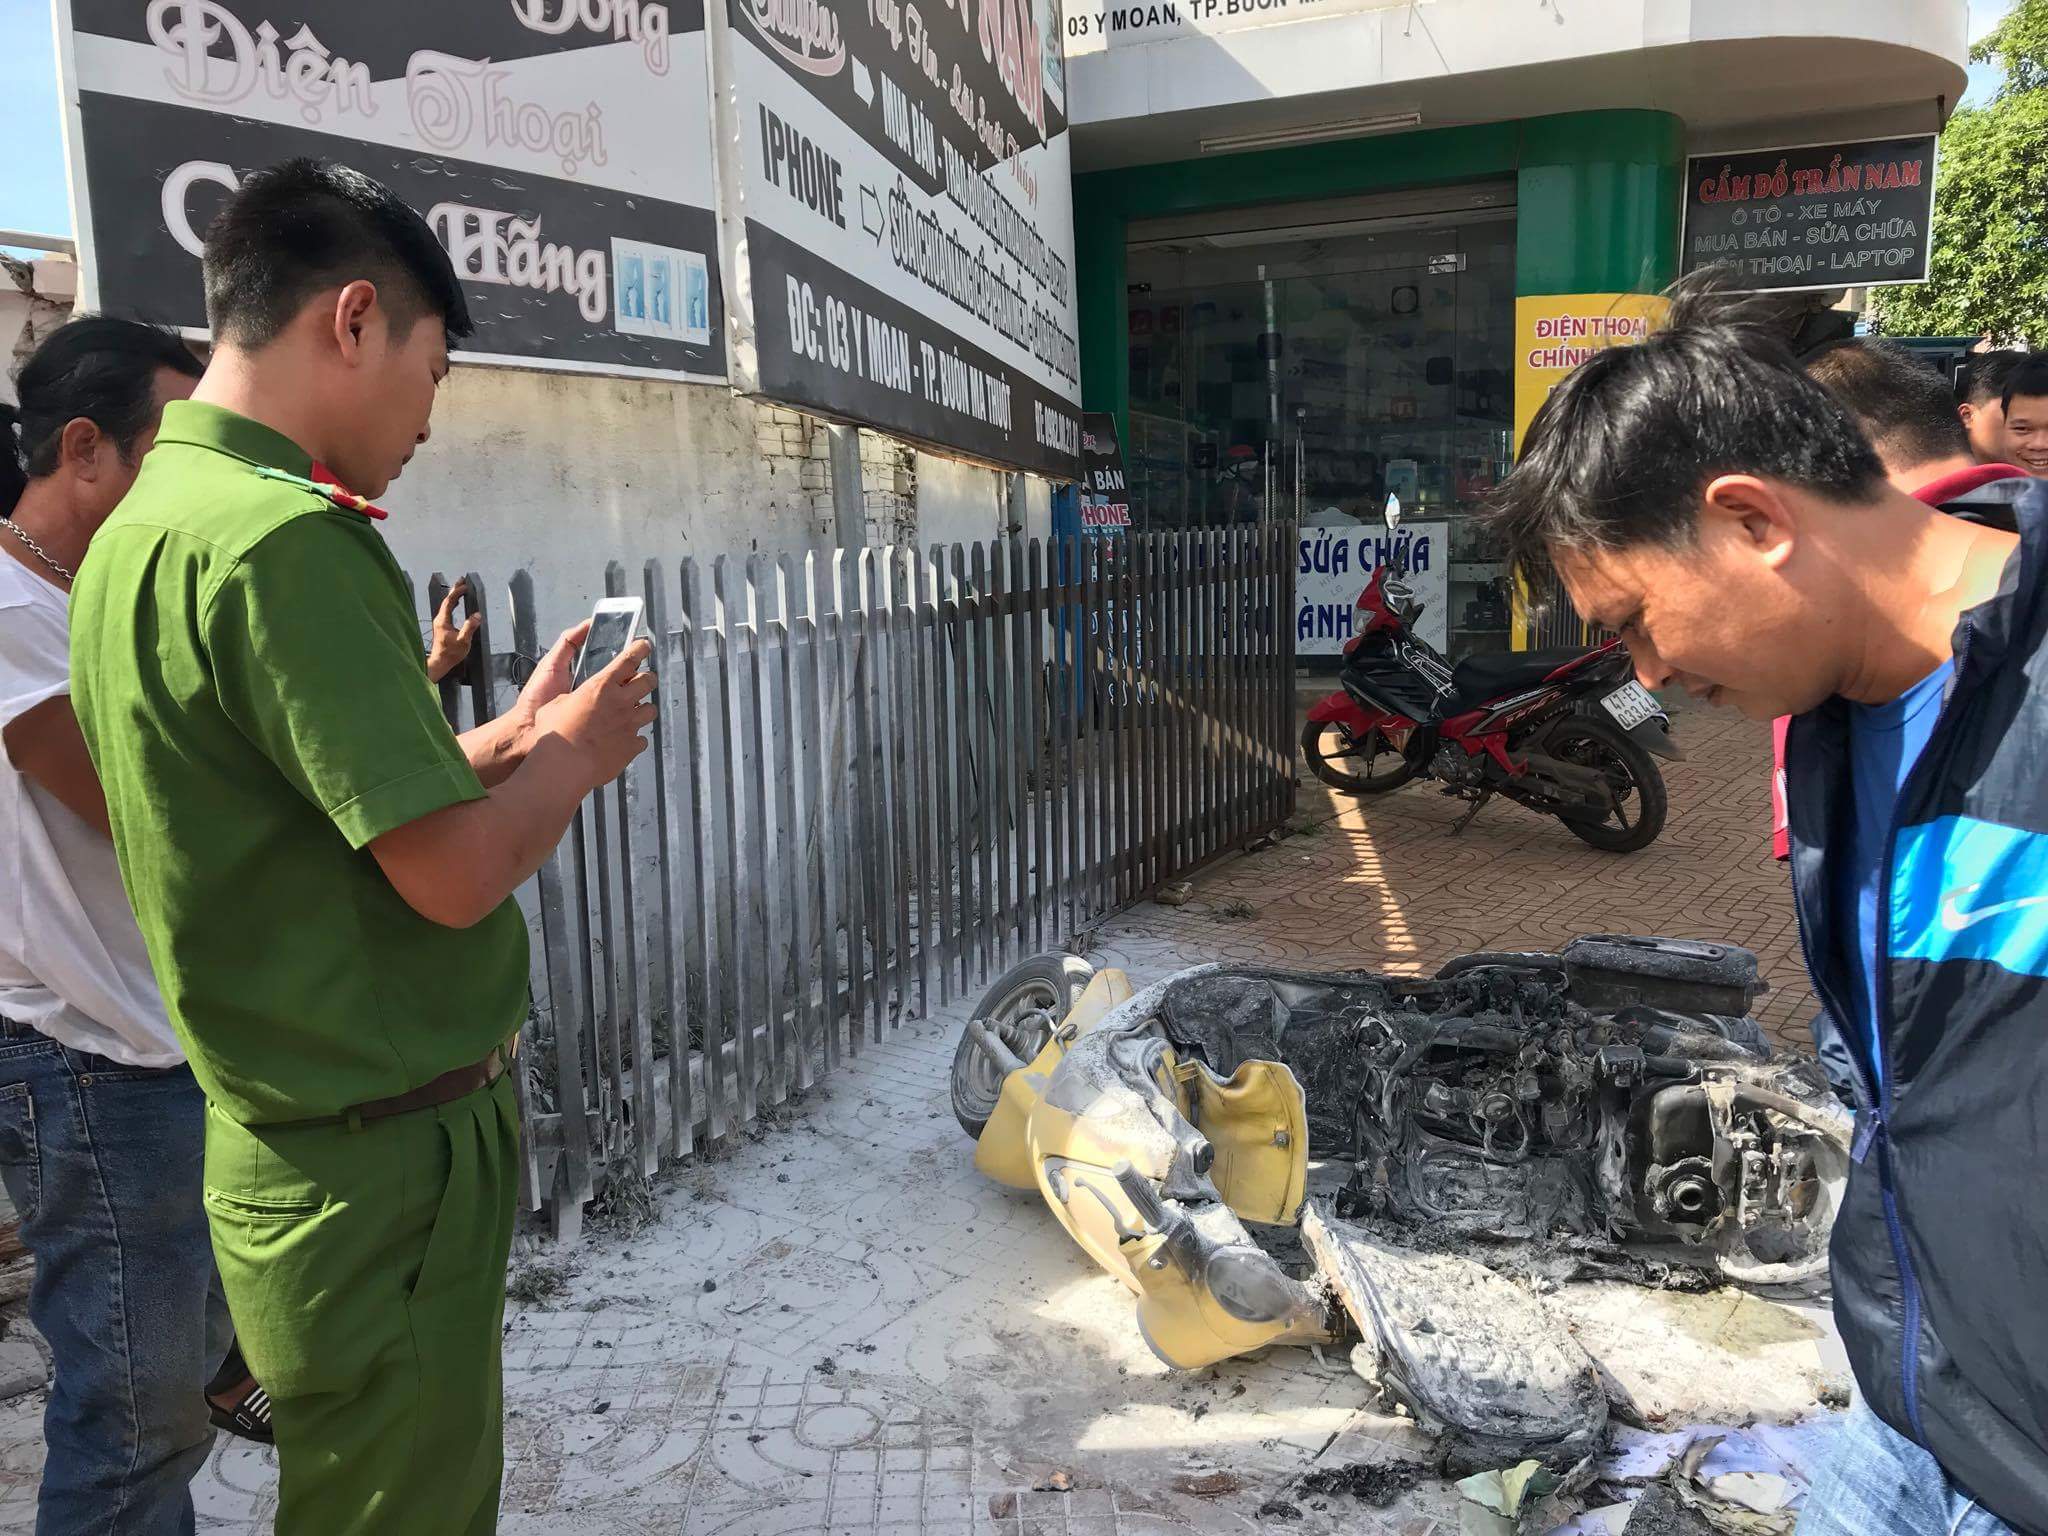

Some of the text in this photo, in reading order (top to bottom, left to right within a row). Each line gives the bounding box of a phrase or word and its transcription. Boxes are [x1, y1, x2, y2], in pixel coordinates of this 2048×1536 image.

[1068, 15, 1088, 36] 03
[1095, 13, 1105, 34] Y
[1112, 4, 1181, 31] MOAN,
[147, 0, 608, 174] Điện Thoại
[759, 102, 846, 229] IPHONE
[1864, 159, 1923, 190] NAM
[1731, 207, 1748, 225] Ô
[1752, 204, 1782, 224] TÔ
[1798, 203, 1828, 220] XE
[1833, 197, 1882, 217] MÁY
[1695, 233, 1739, 253] MUA
[1744, 227, 1788, 249] BÁN
[1806, 221, 1850, 245] SỬA
[1855, 216, 1917, 241] CHỮA
[426, 201, 606, 323] Hãng
[1749, 253, 1812, 275] THOẠI
[1830, 247, 1915, 269] LAPTOP
[1536, 314, 1648, 342] ĐIỆN THOẠI
[786, 273, 824, 363] ĐC:
[826, 295, 850, 373] 03
[851, 306, 863, 377] Y
[866, 314, 912, 394] MOAN
[939, 345, 970, 416] BUÔN
[968, 365, 987, 422] MA
[1094, 465, 1125, 490] BÁN
[1081, 503, 1131, 526] HONE
[1300, 527, 1349, 577] SỬA
[1297, 596, 1353, 642] ÀNH
